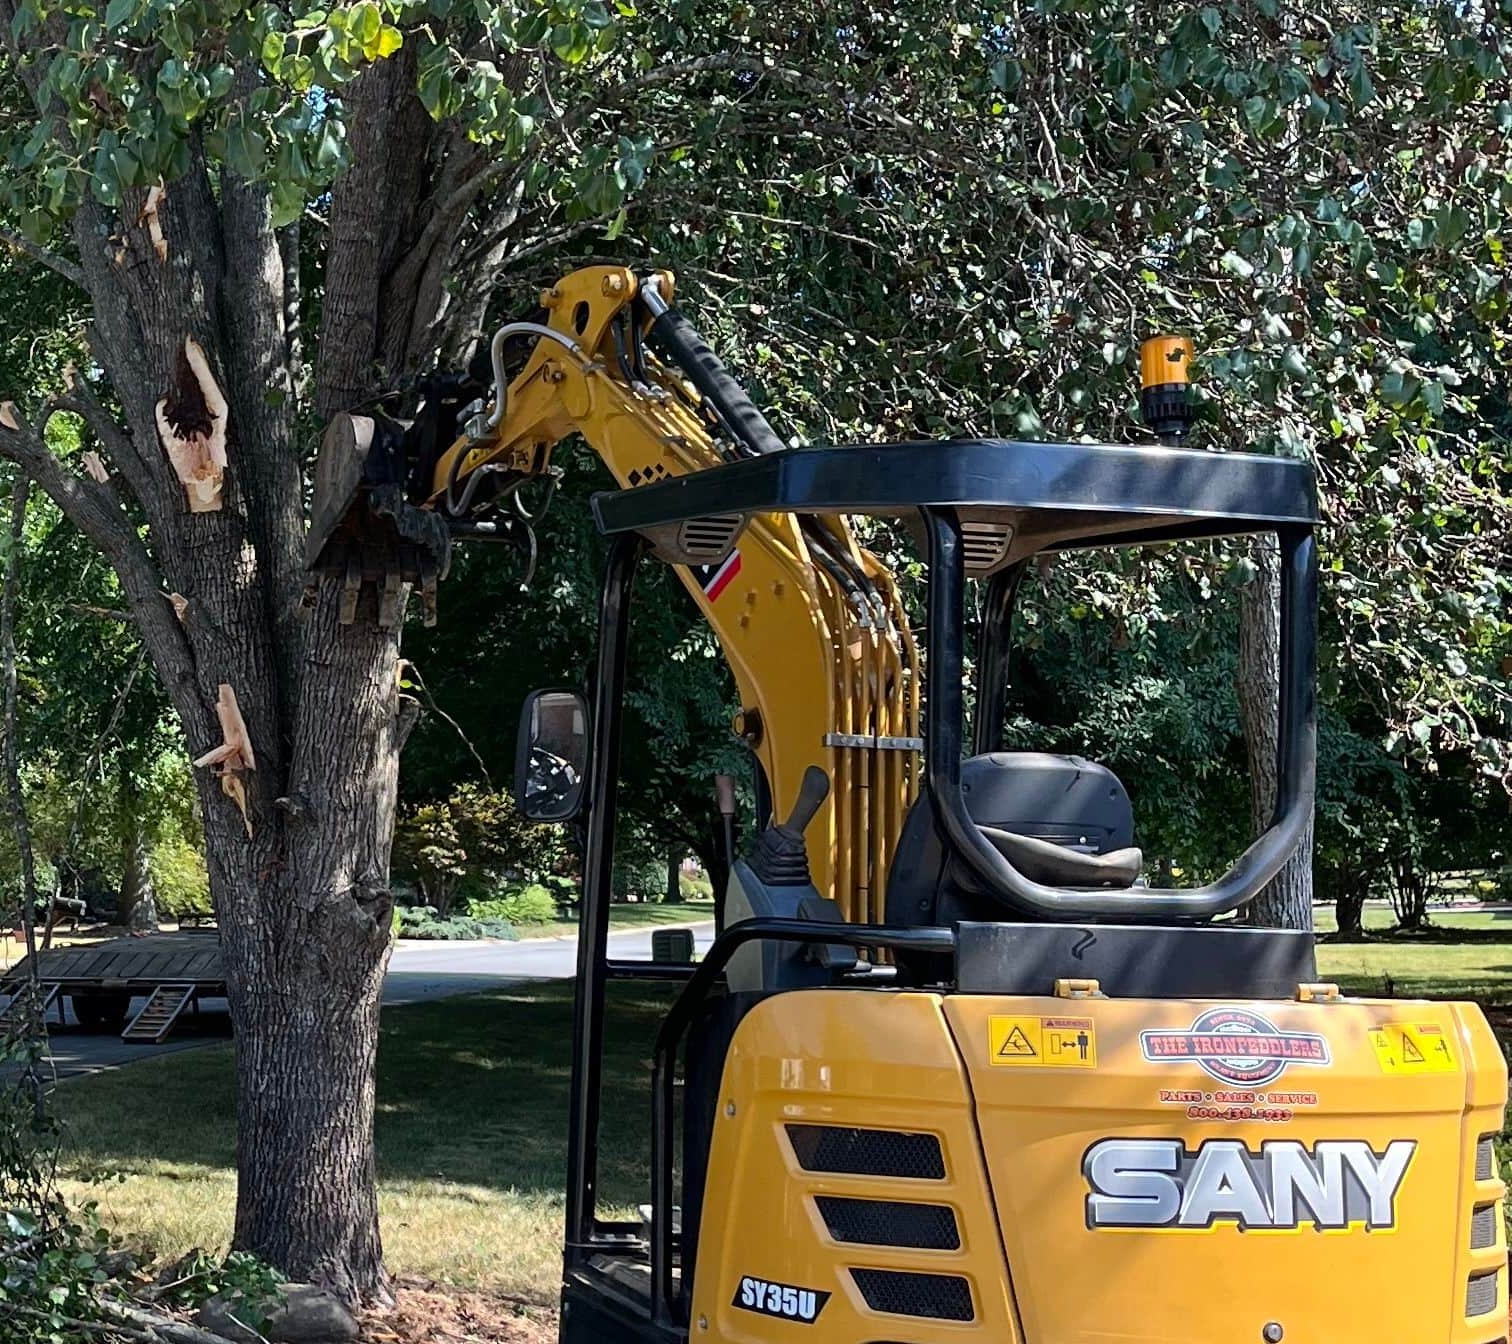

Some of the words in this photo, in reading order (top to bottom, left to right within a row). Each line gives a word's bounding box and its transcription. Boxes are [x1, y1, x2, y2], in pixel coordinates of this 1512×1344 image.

[1150, 1037, 1188, 1055] THE
[1192, 1037, 1322, 1058] IRONPEDDLERS
[1160, 1091, 1202, 1102] PARTS
[1215, 1092, 1255, 1103] SALES
[1268, 1093, 1317, 1104] SERVICE
[1084, 1138, 1418, 1228] SANY
[741, 1277, 816, 1320] SY35U
